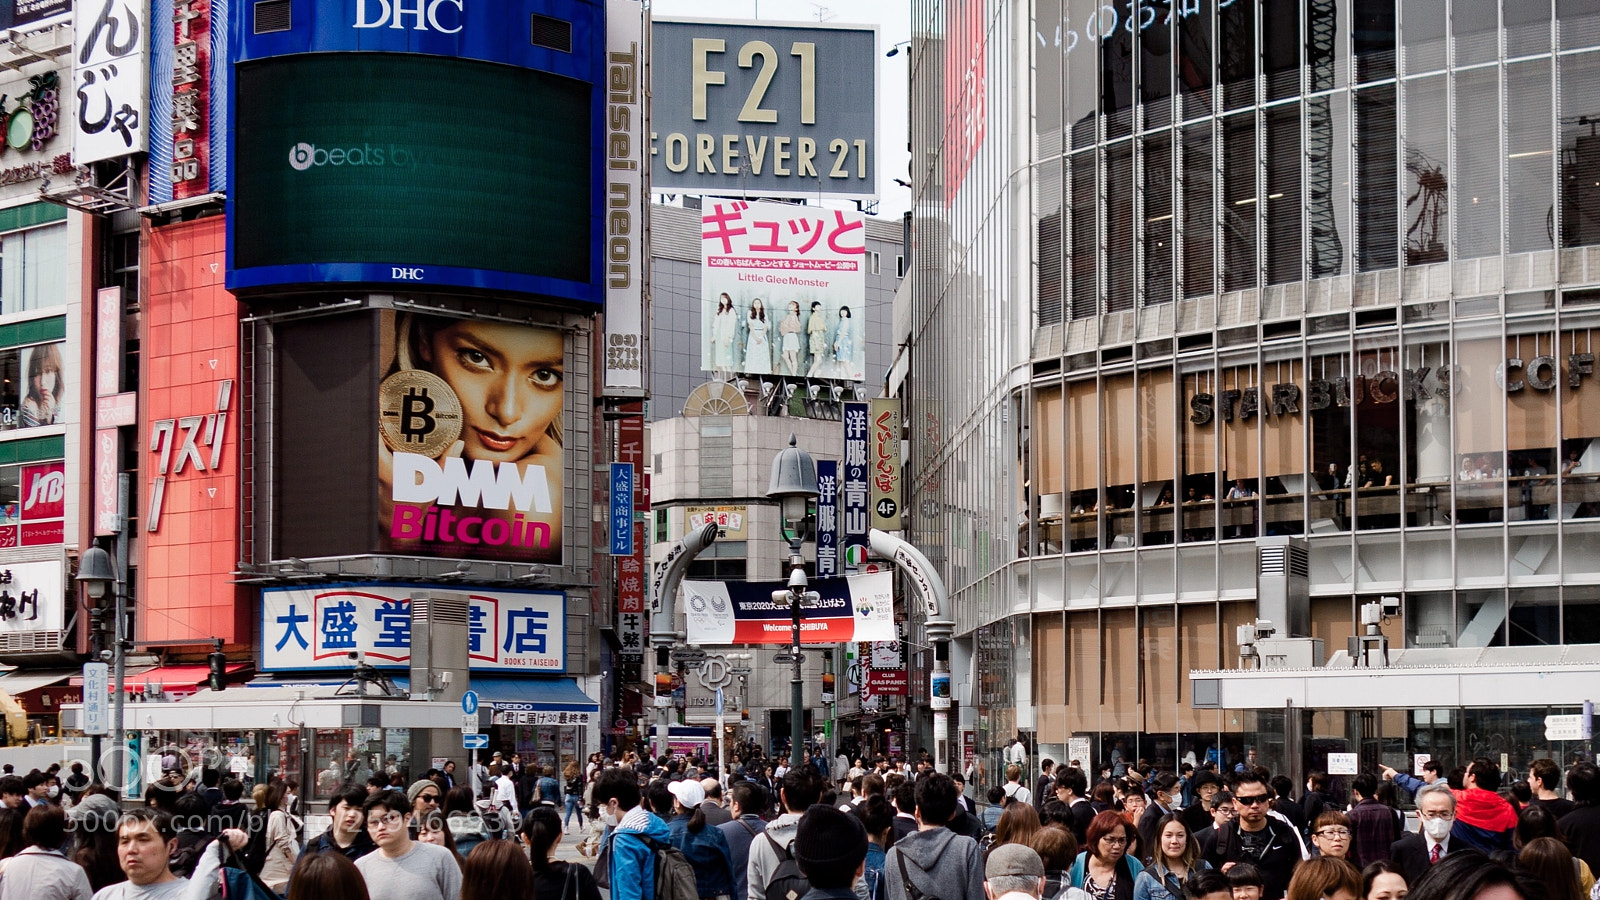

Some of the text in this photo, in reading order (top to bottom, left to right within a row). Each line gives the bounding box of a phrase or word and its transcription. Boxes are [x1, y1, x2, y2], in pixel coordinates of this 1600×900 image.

[352, 0, 463, 33] DHC
[78, 0, 139, 147] んじゃ
[692, 38, 815, 124] F21
[312, 143, 384, 166] beats
[609, 42, 637, 289] Taisei neon
[829, 138, 866, 178] 21
[702, 201, 866, 255] ギュッと
[392, 267, 424, 280] DHC
[738, 273, 829, 288] Little Glee Monster
[609, 333, 638, 347] (03)
[1190, 364, 1462, 425] STARBUCKS
[435, 413, 459, 421] Bitcoin
[24, 471, 64, 510] JTB
[392, 452, 552, 513] DMM
[846, 410, 867, 534] 洋服の青山
[391, 504, 551, 548] Bitcoin
[615, 468, 629, 551] 大盛堂商事ビル
[817, 475, 837, 579] 洋服の青
[877, 501, 895, 515] 4F
[622, 614, 640, 648] 牛繁
[763, 622, 828, 632] Welcome SHIBUYA
[504, 657, 559, 667] BOOKS TAISEIDO
[88, 669, 99, 723] 文化村通り
